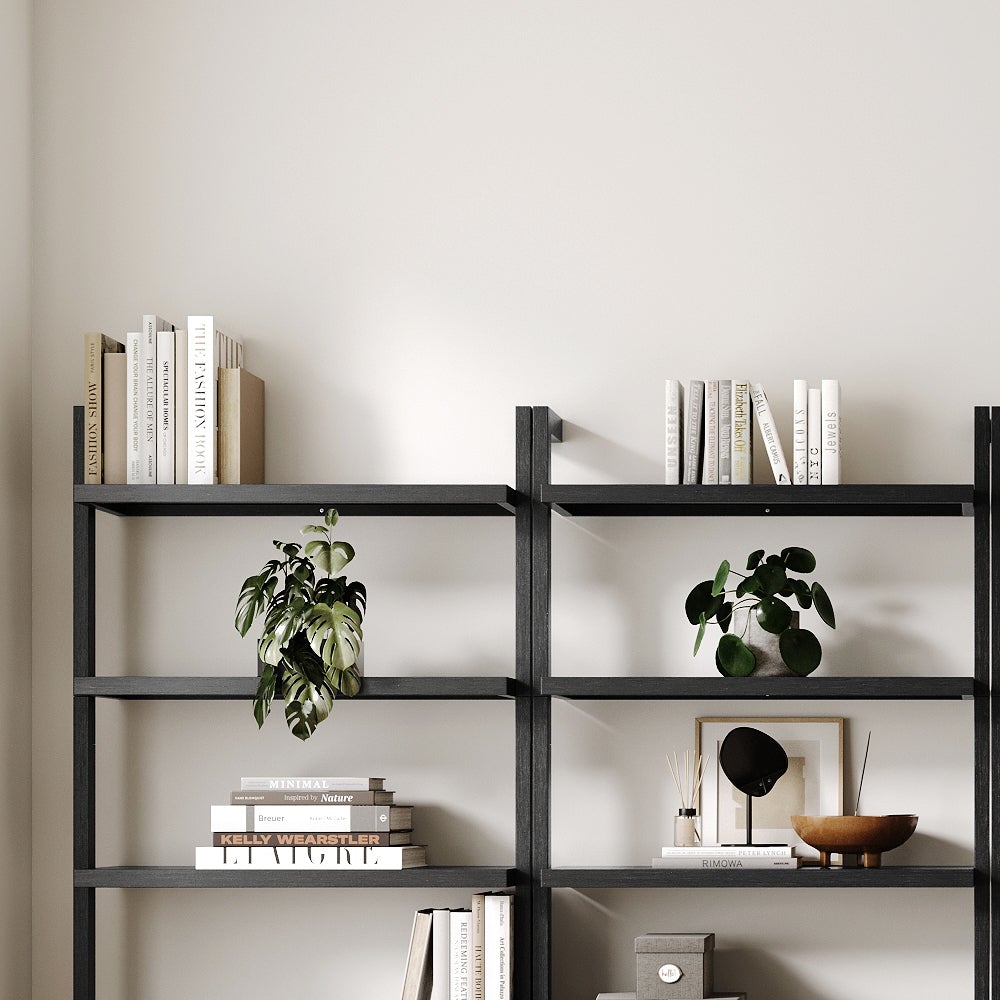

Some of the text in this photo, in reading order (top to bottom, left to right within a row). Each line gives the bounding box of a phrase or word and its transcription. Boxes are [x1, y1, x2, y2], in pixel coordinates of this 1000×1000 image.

[194, 324, 206, 475] THE FASHION BOOK
[734, 383, 748, 418] Elizabeth
[753, 392, 764, 417] FALL
[146, 410, 153, 421] OF
[708, 401, 716, 425] TEACHING
[88, 381, 97, 476] FASHION SHOW
[667, 405, 677, 468] UNSEEN
[708, 426, 716, 435] THE
[734, 418, 748, 439] Takes
[795, 409, 806, 452] ICONS
[824, 411, 837, 454] Jewels
[734, 440, 748, 453] Off
[762, 422, 781, 465] ALBERT CAMUS
[810, 447, 818, 480] NYC
[269, 780, 329, 789] MINIMAL
[284, 793, 354, 803] Inspired by Nature
[258, 814, 285, 822] Breuer
[220, 834, 380, 845] KELLY WEARSTLER
[702, 860, 743, 868] RIMOWA
[460, 922, 468, 974] REDEEMING
[474, 945, 482, 976] HAUTE
